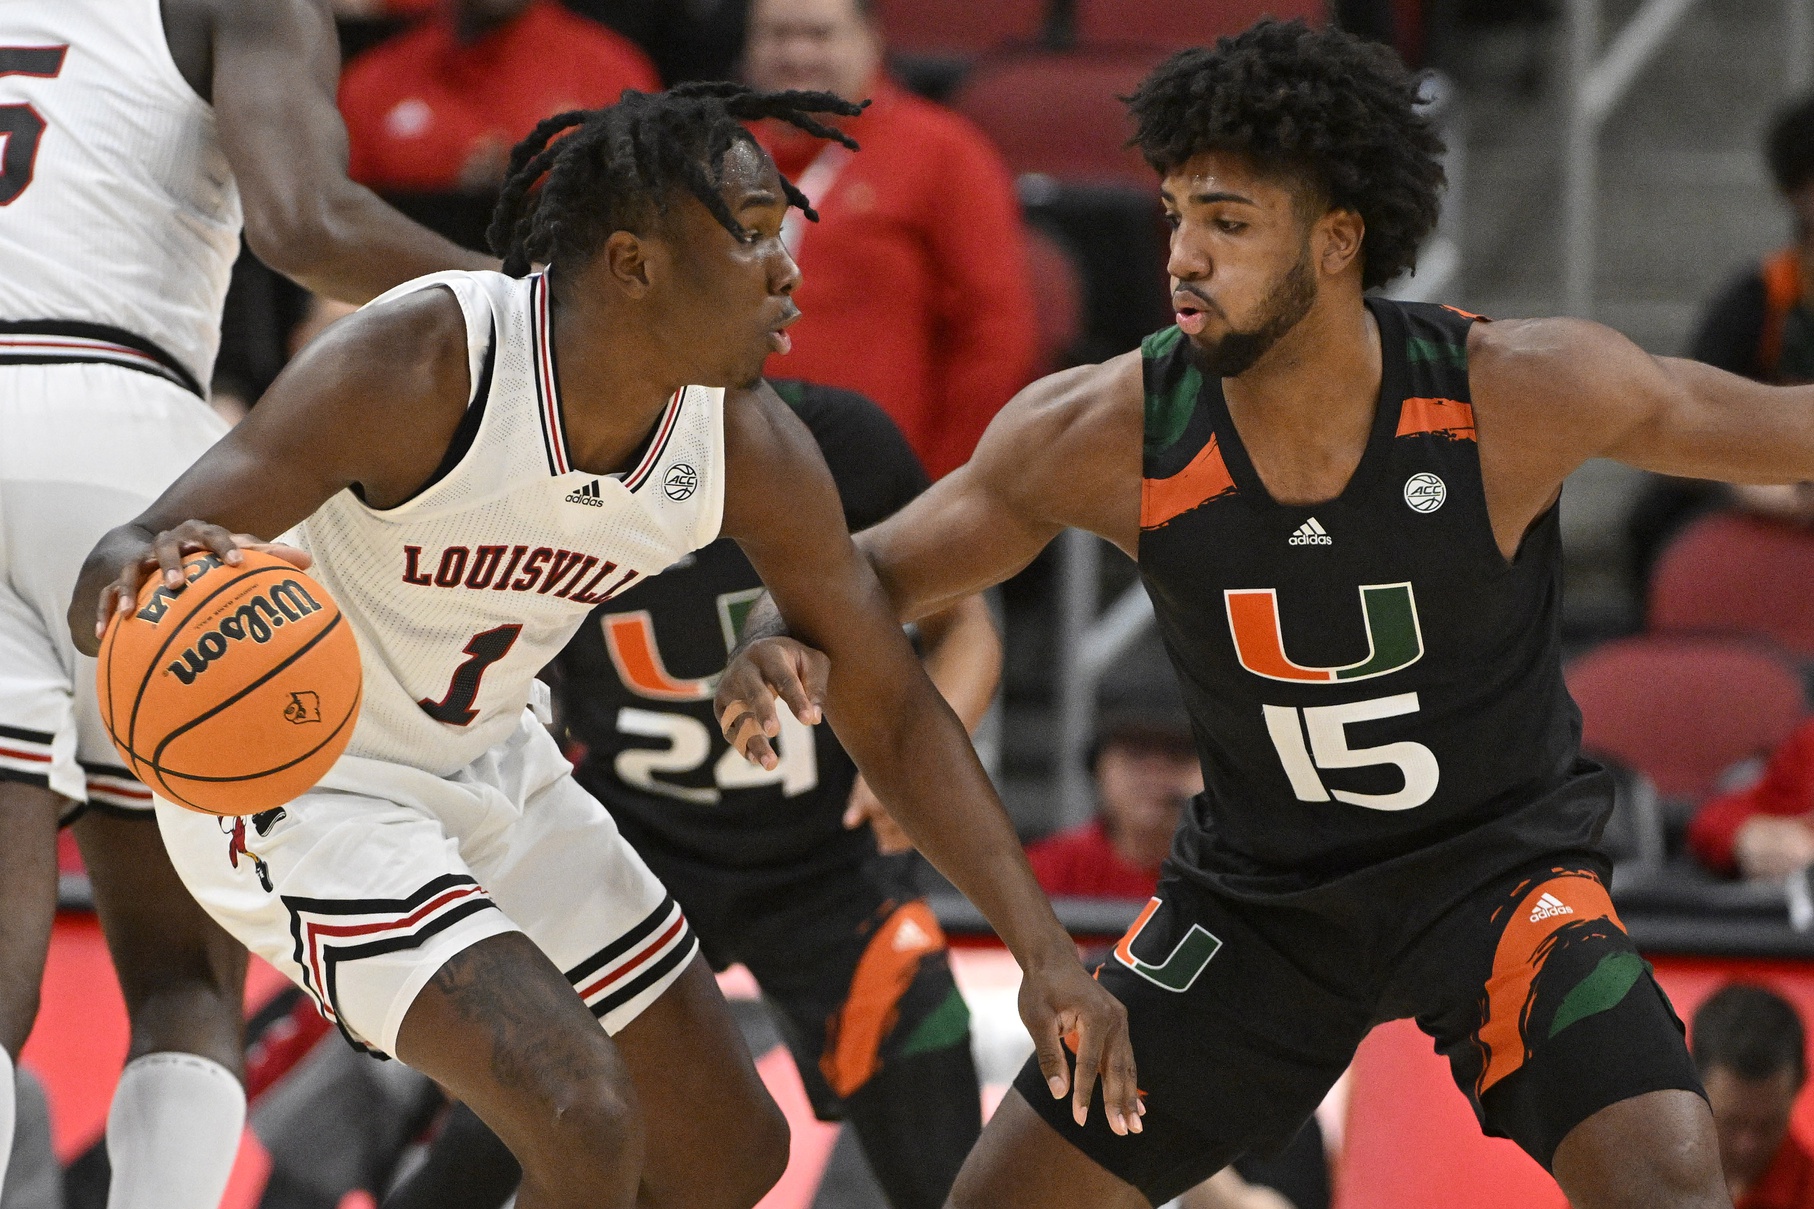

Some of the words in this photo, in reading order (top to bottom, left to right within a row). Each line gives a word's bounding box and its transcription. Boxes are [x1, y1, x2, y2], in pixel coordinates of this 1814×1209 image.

[564, 493, 604, 508] adidas
[1410, 485, 1442, 496] ACC
[402, 545, 640, 604] LOUISVILL
[1288, 533, 1333, 546] adidas
[167, 579, 322, 685] Wilson
[417, 623, 523, 726] 1
[1223, 581, 1425, 684] U
[614, 706, 819, 805] 24
[1261, 691, 1440, 812] 15
[1113, 896, 1223, 993] U
[1529, 905, 1574, 923] adidas
